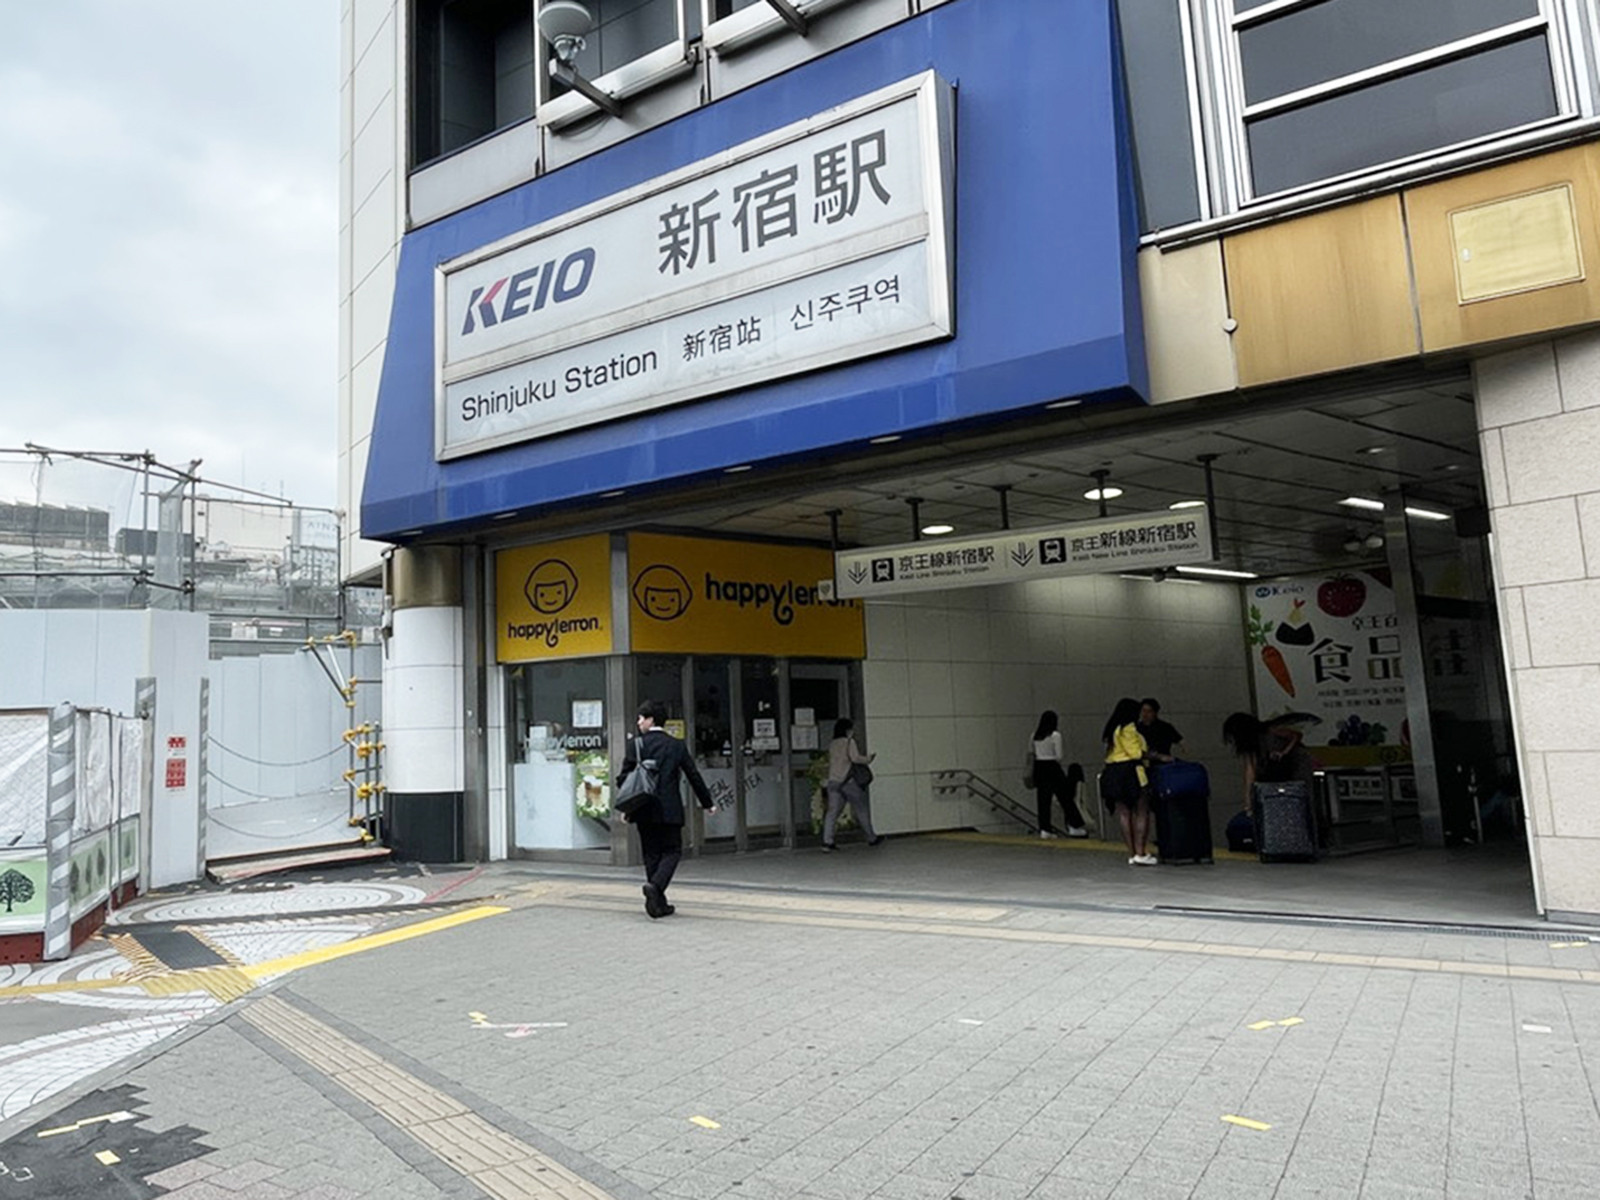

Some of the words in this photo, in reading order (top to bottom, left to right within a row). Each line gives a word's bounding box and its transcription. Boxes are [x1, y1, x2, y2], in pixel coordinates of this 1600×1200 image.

[658, 129, 892, 276] 新宿駅
[461, 247, 596, 336] KEIO
[789, 275, 901, 332] 신주쿠역
[682, 316, 762, 362] 新宿站
[461, 378, 556, 422] Shinjuku
[564, 350, 658, 393] Station
[899, 546, 994, 572] 京王線新宿駅
[1071, 521, 1197, 552] 京王新線新宿駅
